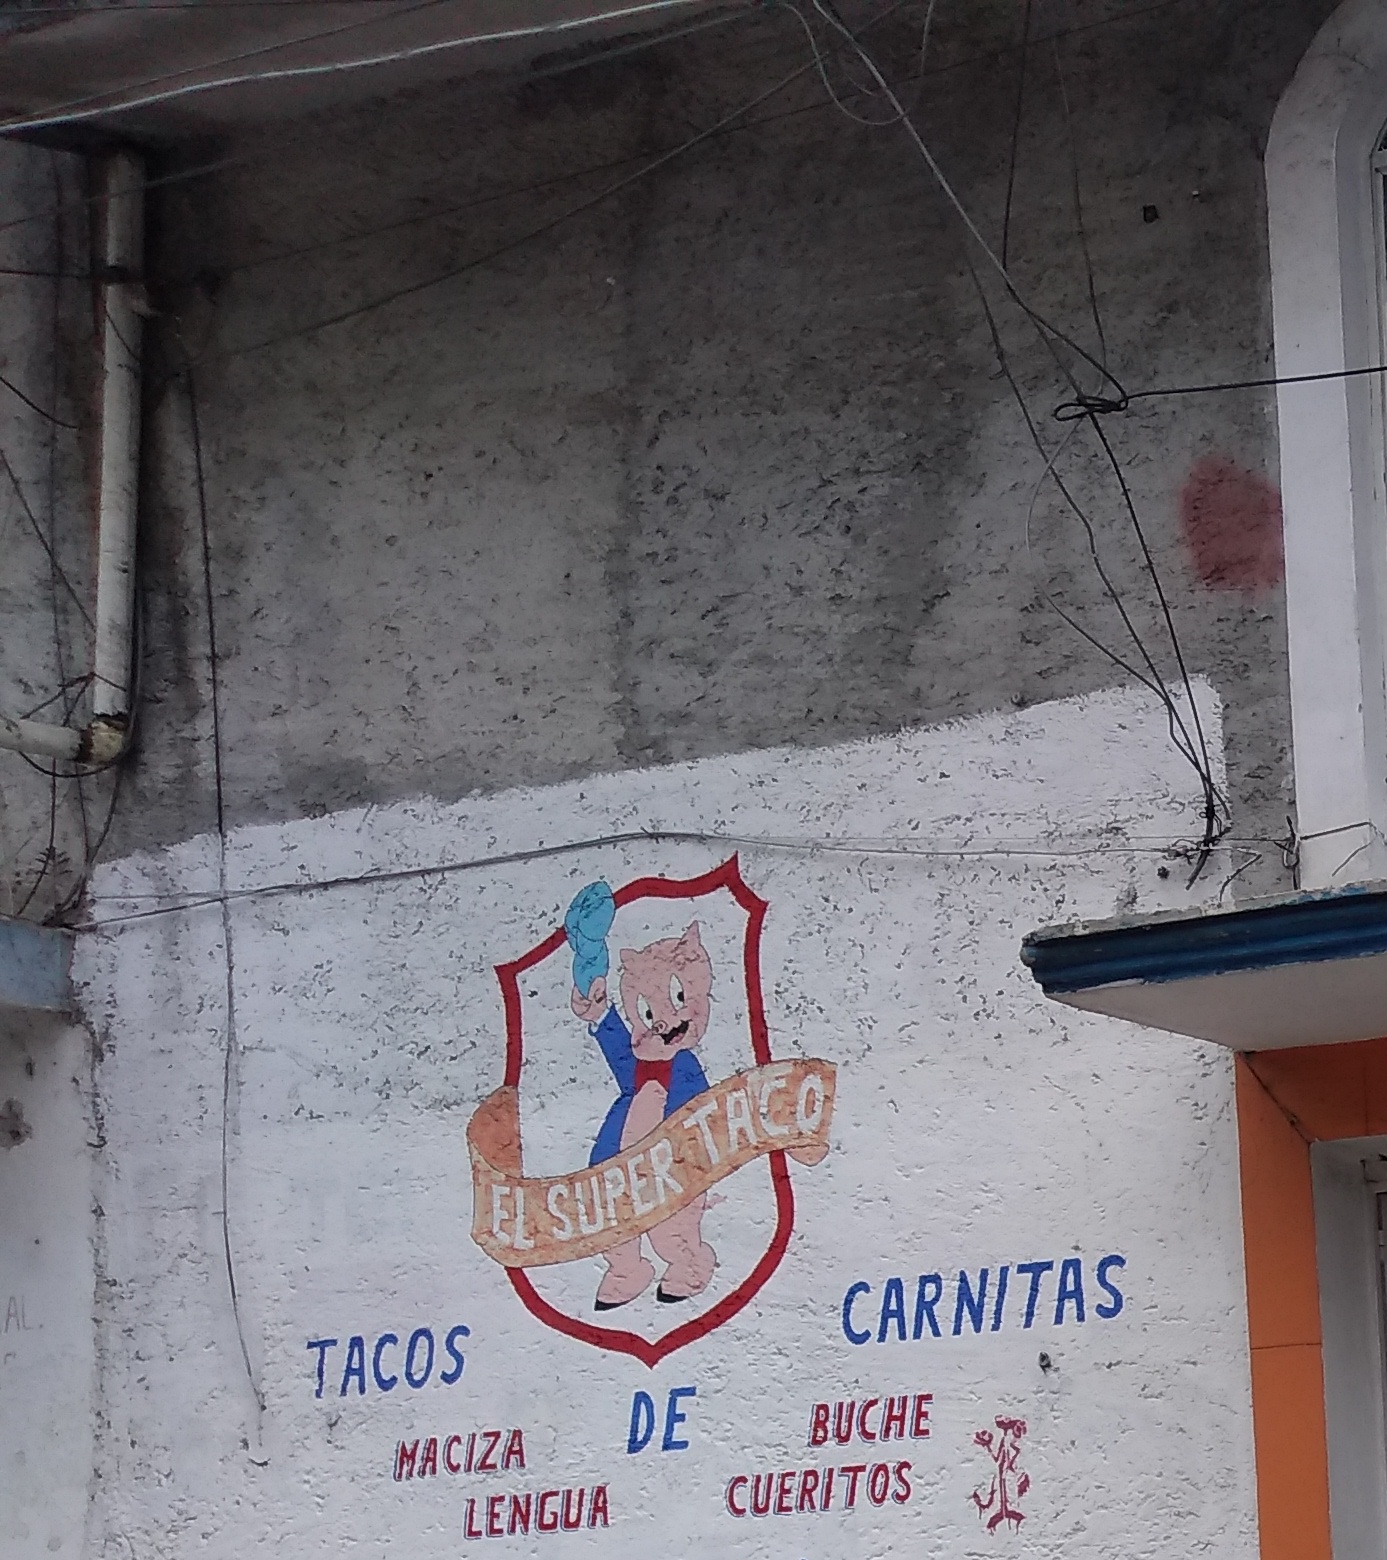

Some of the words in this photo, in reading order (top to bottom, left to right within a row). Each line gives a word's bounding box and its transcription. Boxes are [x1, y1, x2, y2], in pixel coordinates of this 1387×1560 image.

[489, 1182, 535, 1251] EL
[546, 1138, 684, 1242] SUPER
[682, 1068, 827, 1167] TACO
[841, 1253, 1127, 1346] CARNITAS
[306, 1324, 471, 1399] TACOS
[626, 1386, 698, 1454] DE
[807, 1393, 935, 1448] BUCHE
[392, 1428, 527, 1482] MACIZA
[462, 1484, 611, 1540] LENGUA
[725, 1460, 914, 1518] CUERITOS
